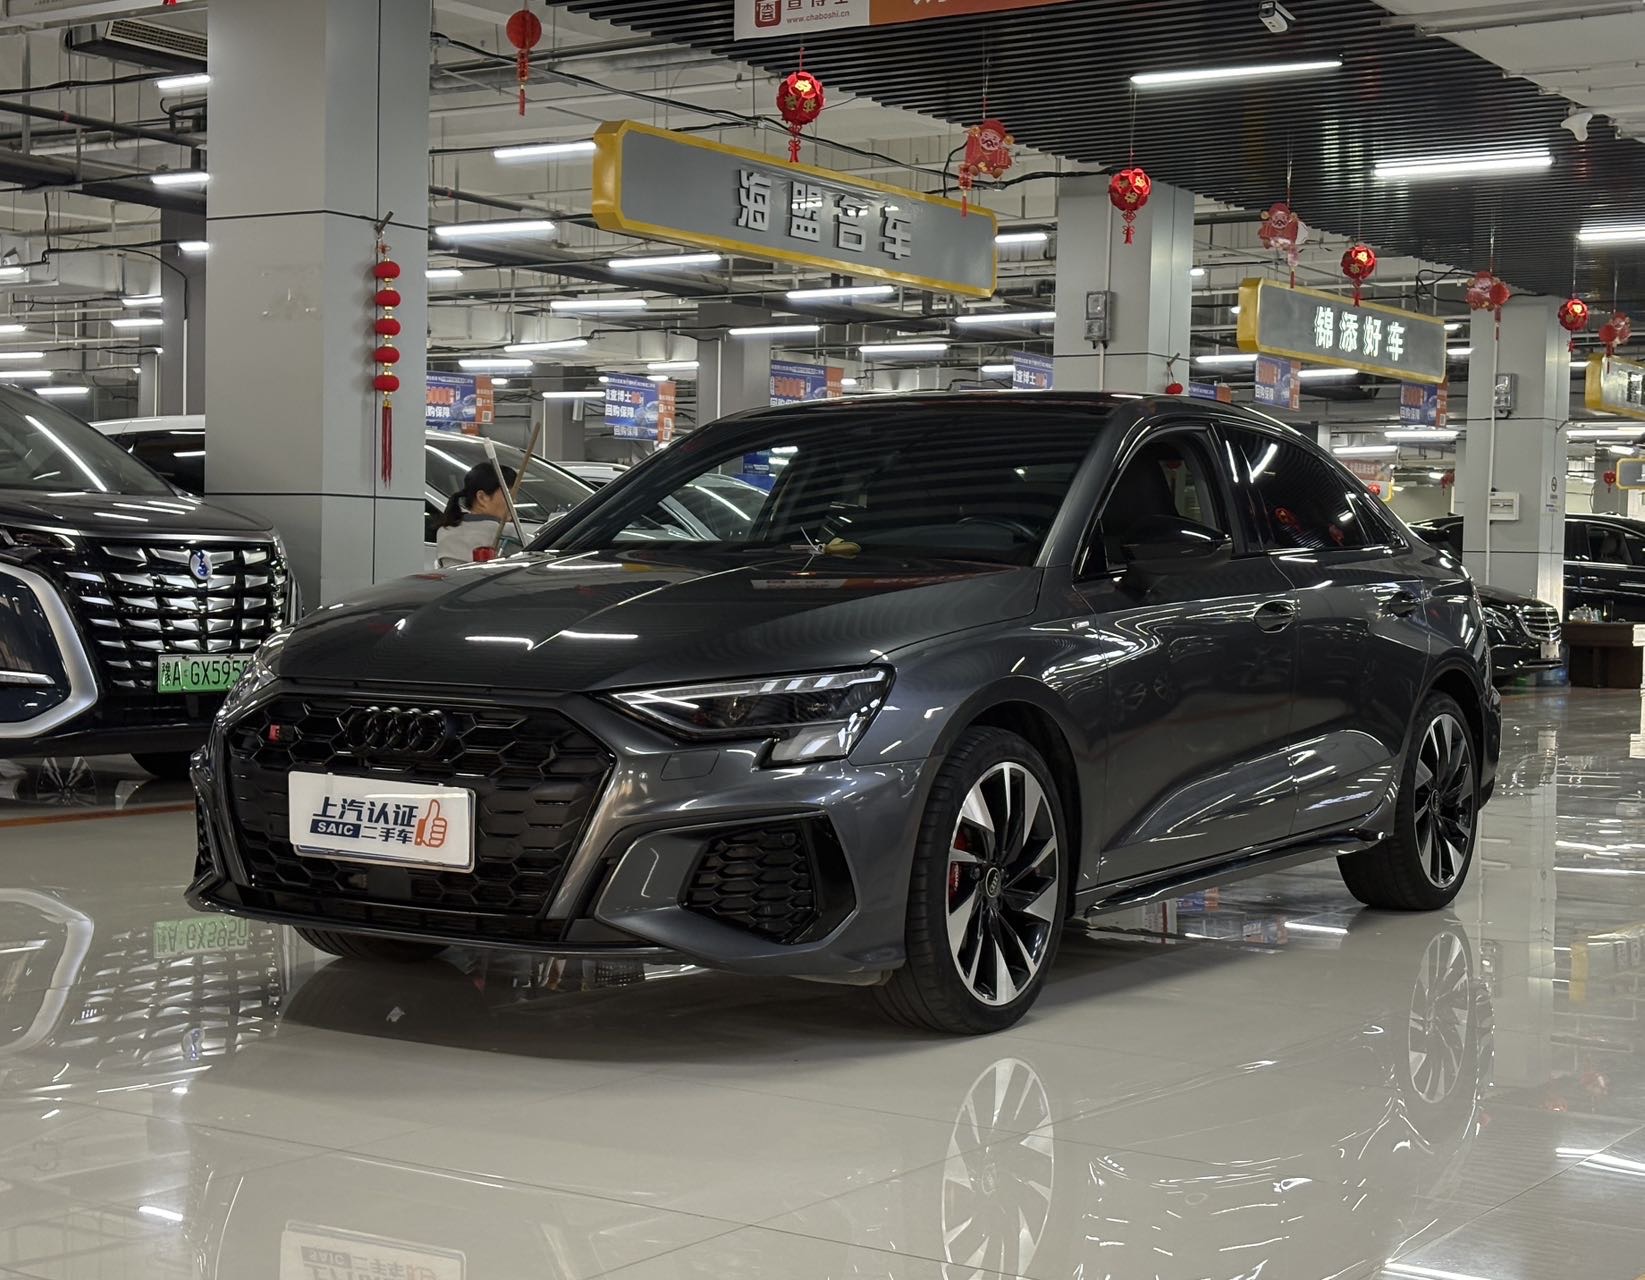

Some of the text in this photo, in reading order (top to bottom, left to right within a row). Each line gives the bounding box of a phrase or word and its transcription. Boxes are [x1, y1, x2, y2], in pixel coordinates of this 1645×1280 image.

[786, 10, 850, 23] www.chaboshi.cn
[1313, 305, 1406, 362] 锦添好车
[425, 406, 451, 418] 购保障
[190, 660, 247, 686] GX595
[312, 796, 419, 828] 上汽认证
[317, 822, 415, 845] SAIC 二手车
